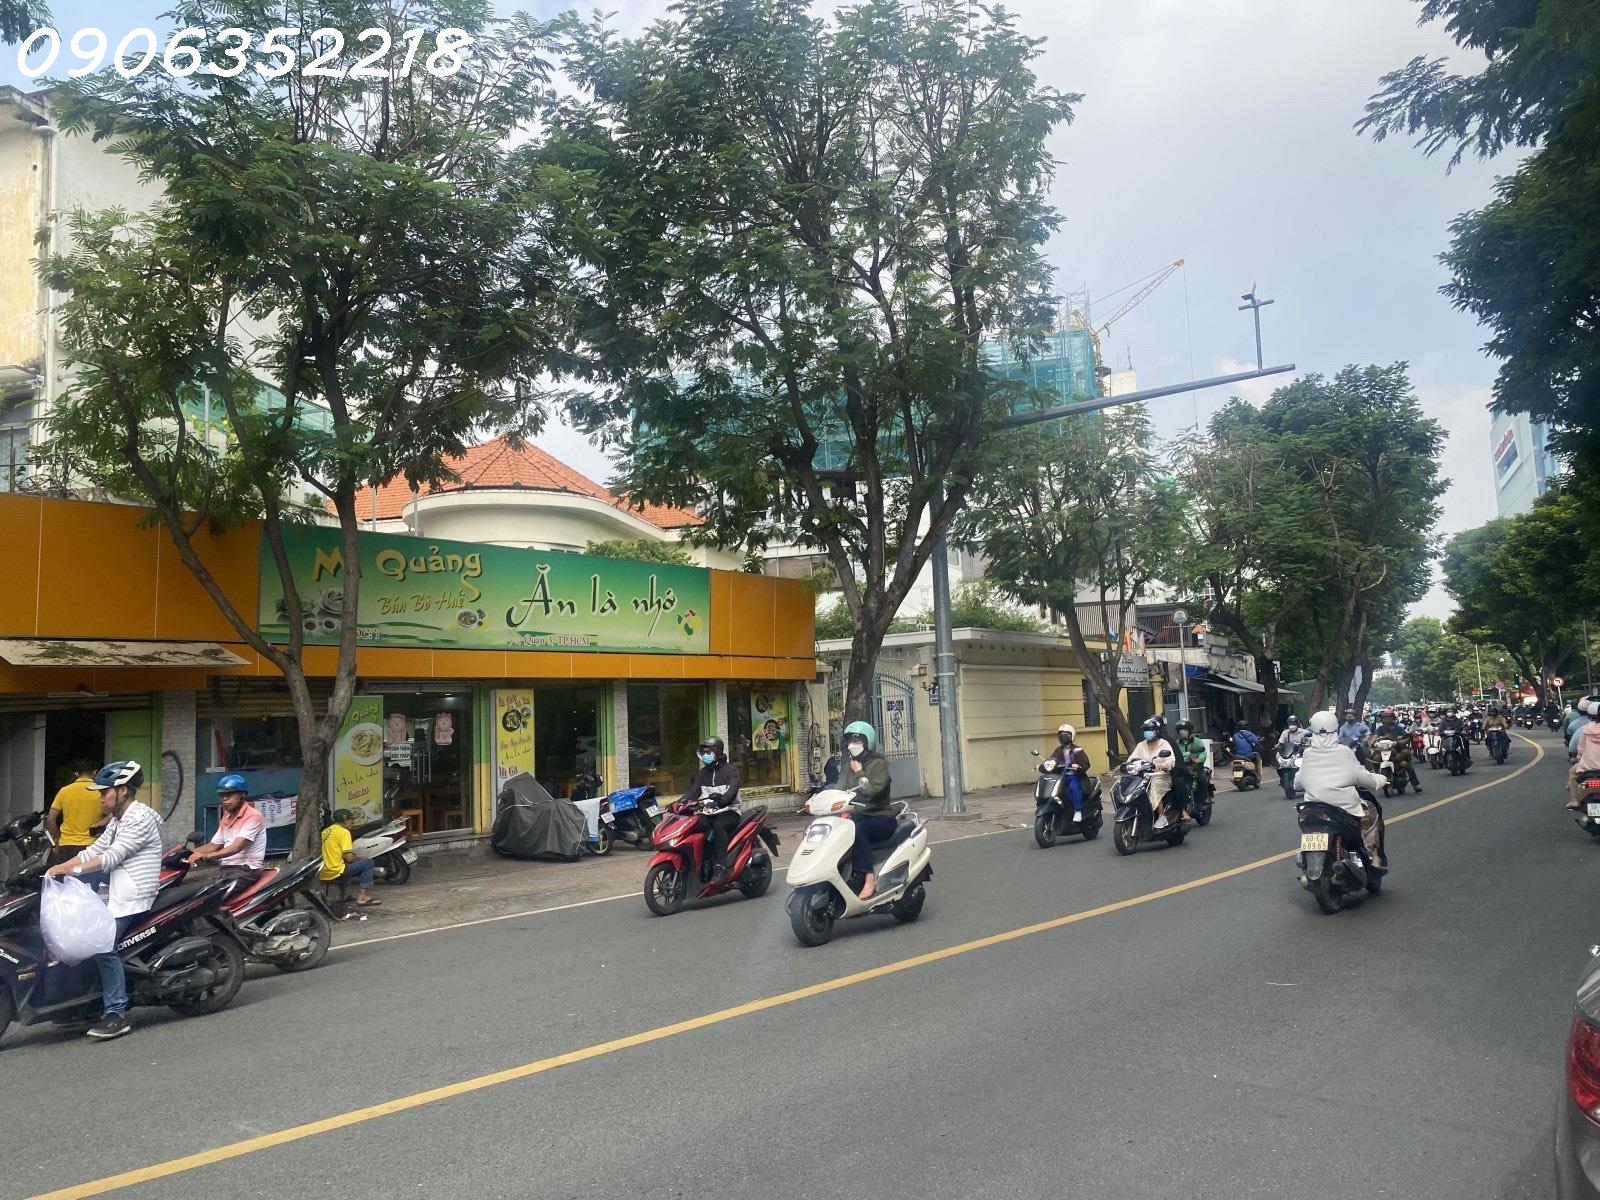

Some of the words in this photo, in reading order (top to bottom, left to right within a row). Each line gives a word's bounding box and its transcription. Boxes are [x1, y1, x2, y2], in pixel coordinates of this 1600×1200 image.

[313, 546, 360, 582] M
[376, 545, 483, 603] Quảng
[505, 563, 577, 629] Ăn
[590, 574, 620, 615] là
[377, 597, 407, 615] Bún
